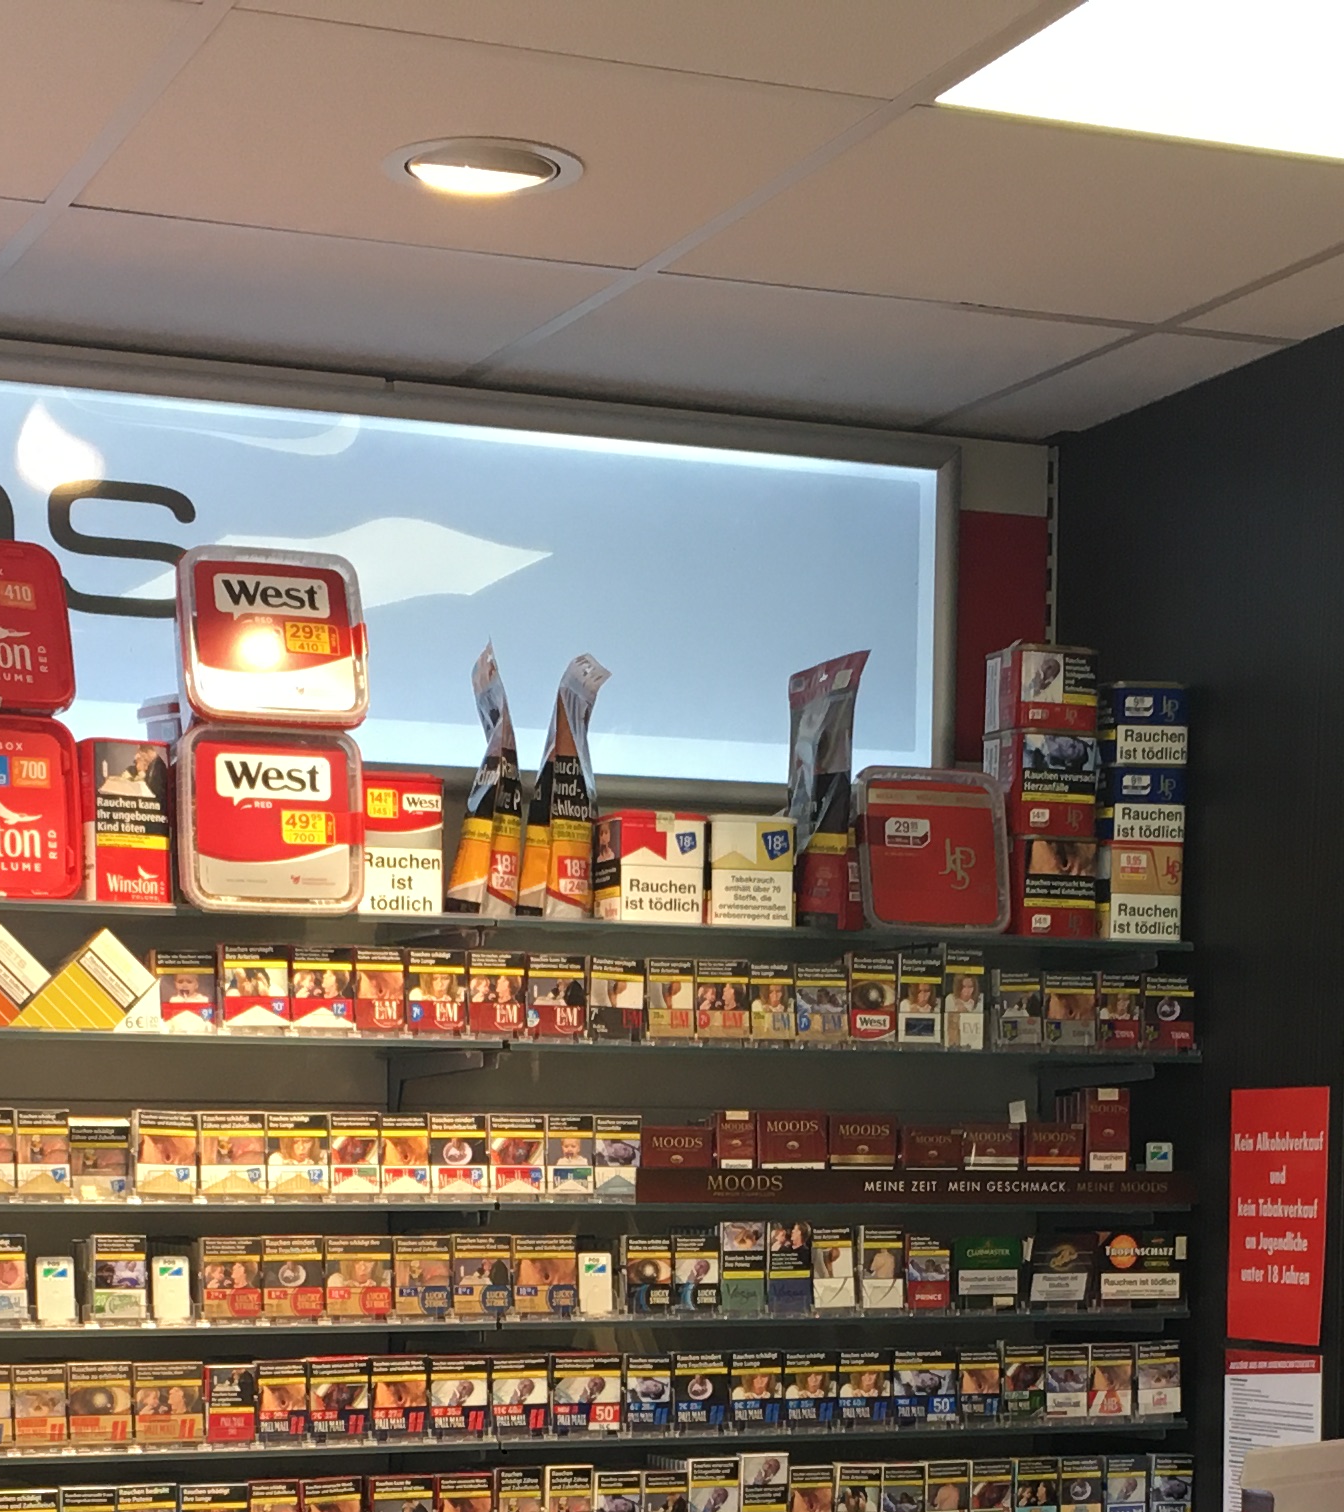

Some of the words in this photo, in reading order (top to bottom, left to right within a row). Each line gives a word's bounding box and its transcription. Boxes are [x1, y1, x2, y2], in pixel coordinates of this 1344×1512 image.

[221, 578, 320, 611] West
[224, 760, 320, 793] West
[629, 878, 696, 895] Rauchen
[625, 897, 644, 911] ist
[648, 895, 700, 913] tödlich
[1234, 1133, 1253, 1152] Kein
[1256, 1131, 1324, 1152] Alkoholverkauf
[707, 1175, 783, 1191] MOODS
[1270, 1165, 1286, 1185] und
[864, 1180, 907, 1191] MEINE
[912, 1180, 941, 1191] ZEIT.
[947, 1181, 982, 1192] MEIN
[986, 1180, 1071, 1192] GESCHMACK.
[1076, 1182, 1113, 1191] MEINE
[1119, 1181, 1169, 1192] MOODS
[1238, 1199, 1256, 1218] kein
[1258, 1198, 1318, 1219] Tabakverkauf
[1245, 1236, 1255, 1250] an
[1258, 1232, 1308, 1256] Jugendliche
[1241, 1268, 1264, 1284] unter
[1267, 1265, 1278, 1284] 18
[1280, 1265, 1310, 1286] Jahren
